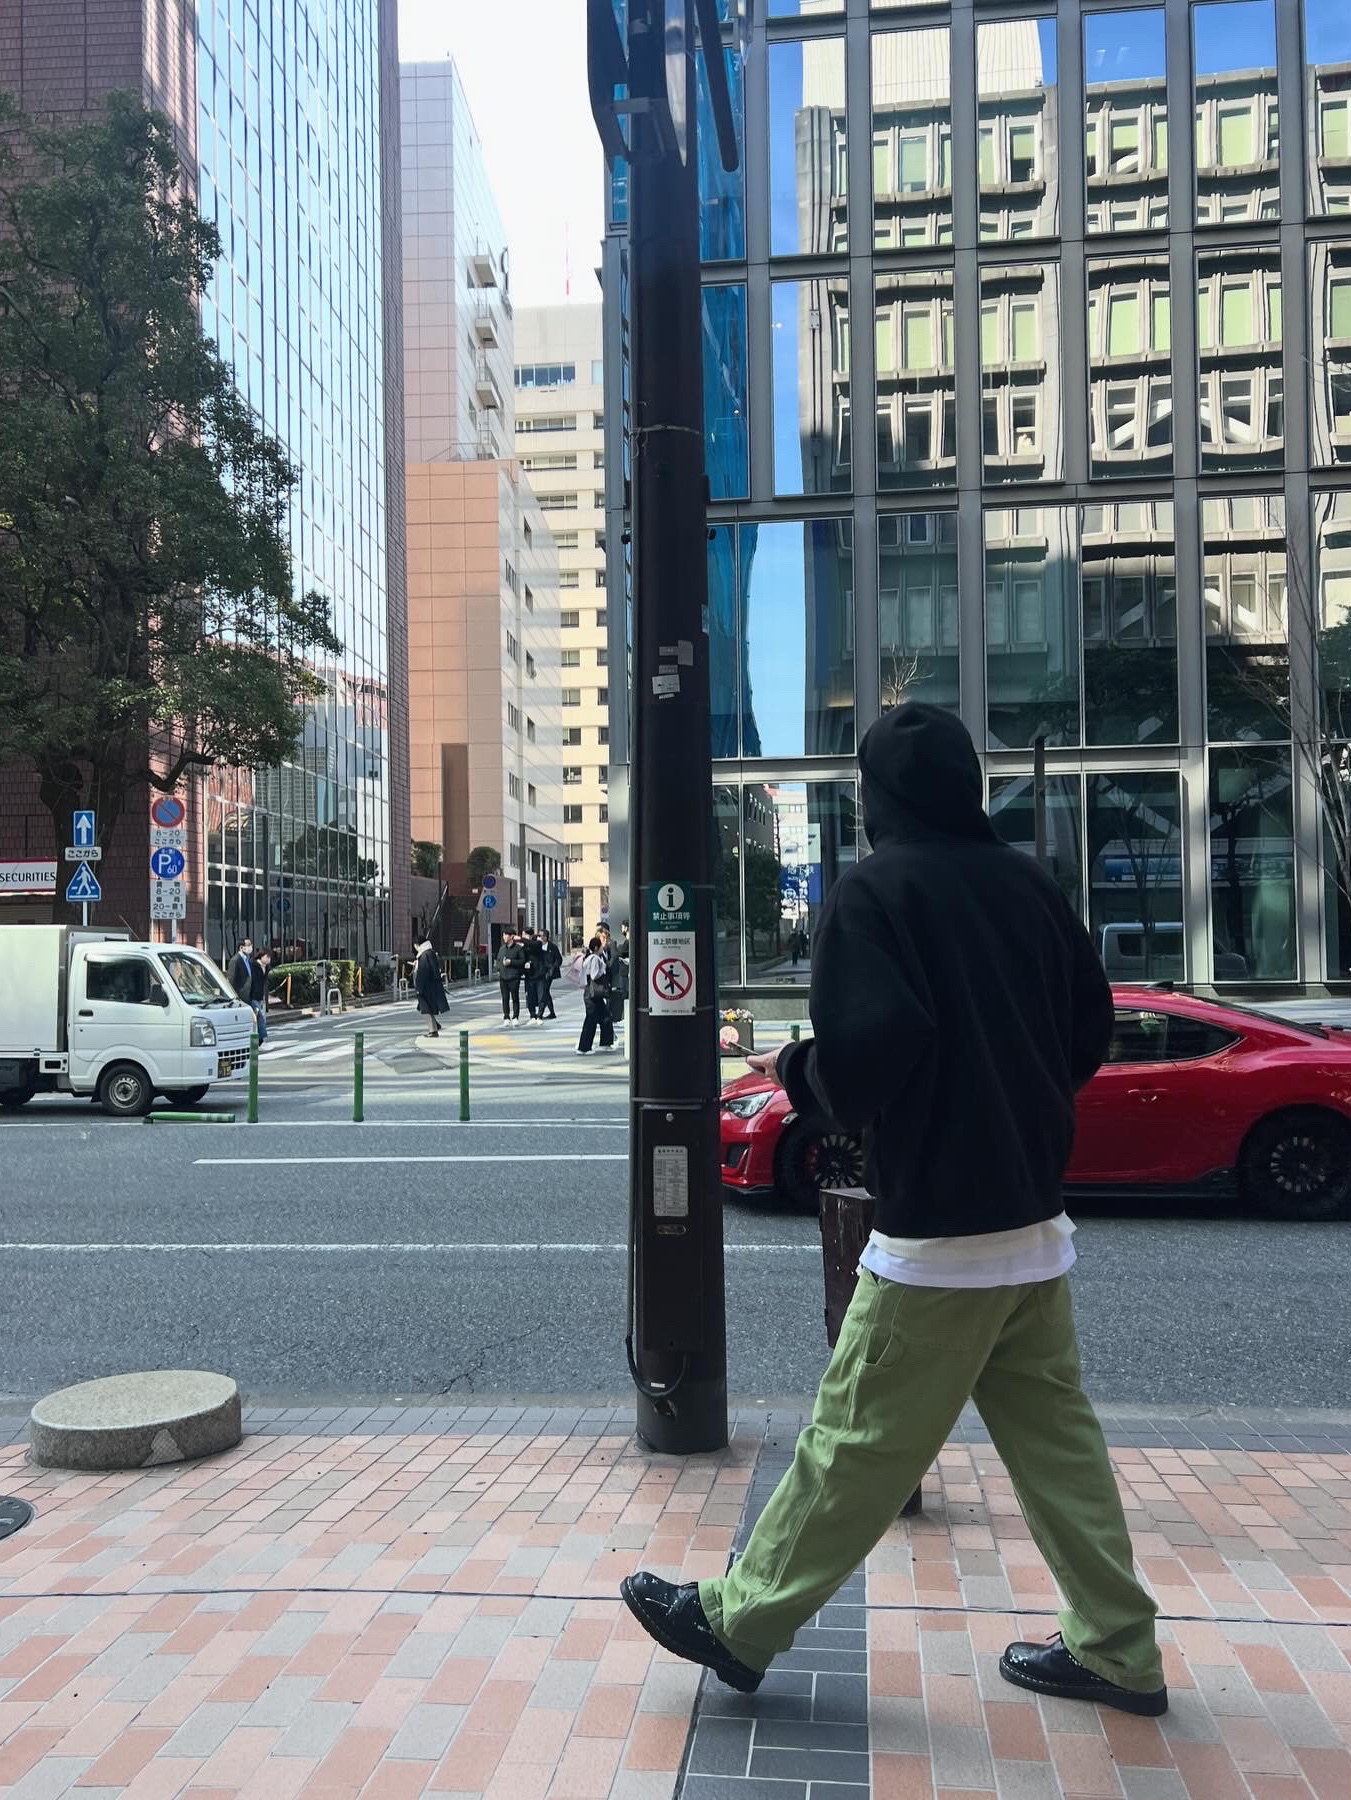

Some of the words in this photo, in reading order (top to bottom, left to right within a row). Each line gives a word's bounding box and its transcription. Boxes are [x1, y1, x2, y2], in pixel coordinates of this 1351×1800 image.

[67, 850, 99, 858] ここから
[158, 853, 172, 874] P
[166, 864, 178, 874] 60
[0, 872, 56, 882] SECURITIES
[652, 912, 691, 921] 禁止事項等
